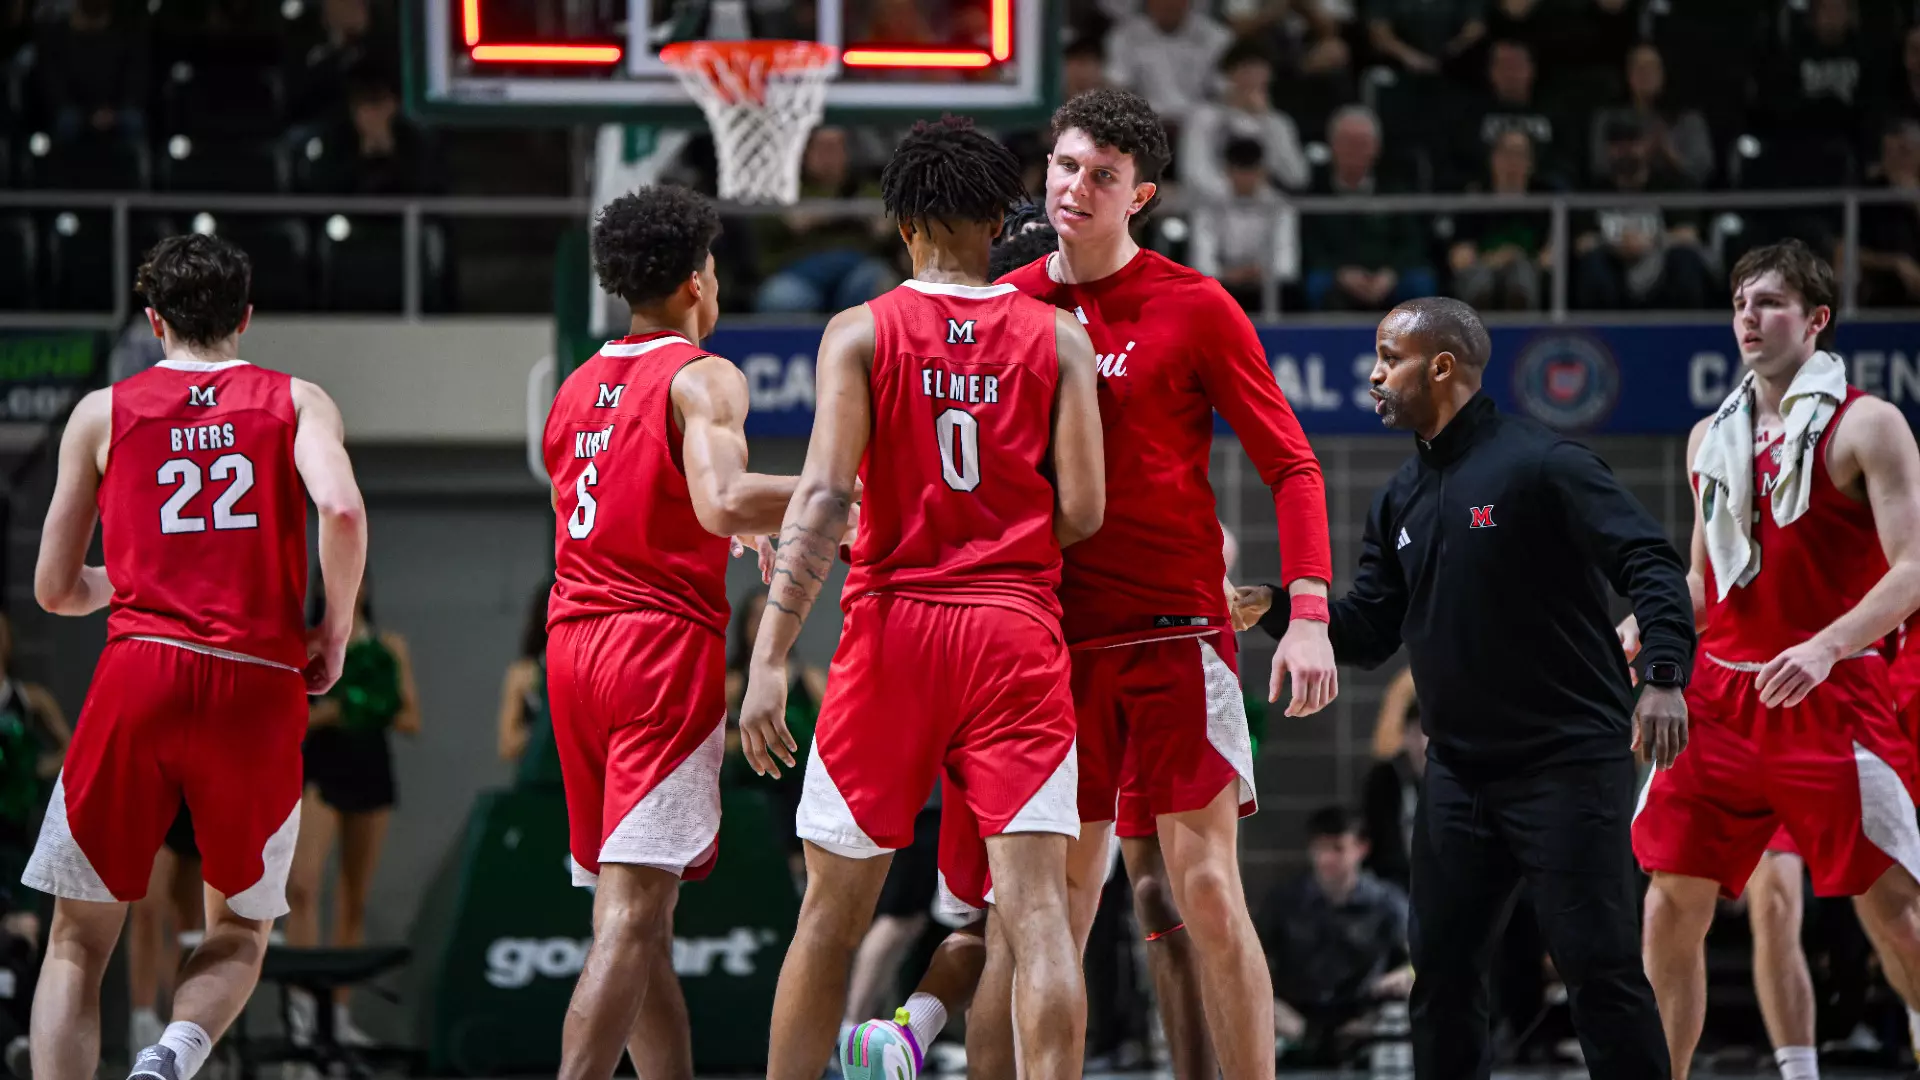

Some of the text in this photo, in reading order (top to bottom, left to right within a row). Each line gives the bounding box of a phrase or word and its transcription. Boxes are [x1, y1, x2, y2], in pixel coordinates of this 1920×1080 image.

[946, 319, 977, 344] M
[187, 384, 218, 406] M
[594, 383, 627, 408] M
[922, 368, 999, 403] ELMER
[170, 422, 235, 452] BYERS
[936, 407, 981, 493] 0
[157, 453, 260, 534] 22
[568, 461, 598, 540] 6
[1470, 504, 1496, 528] M
